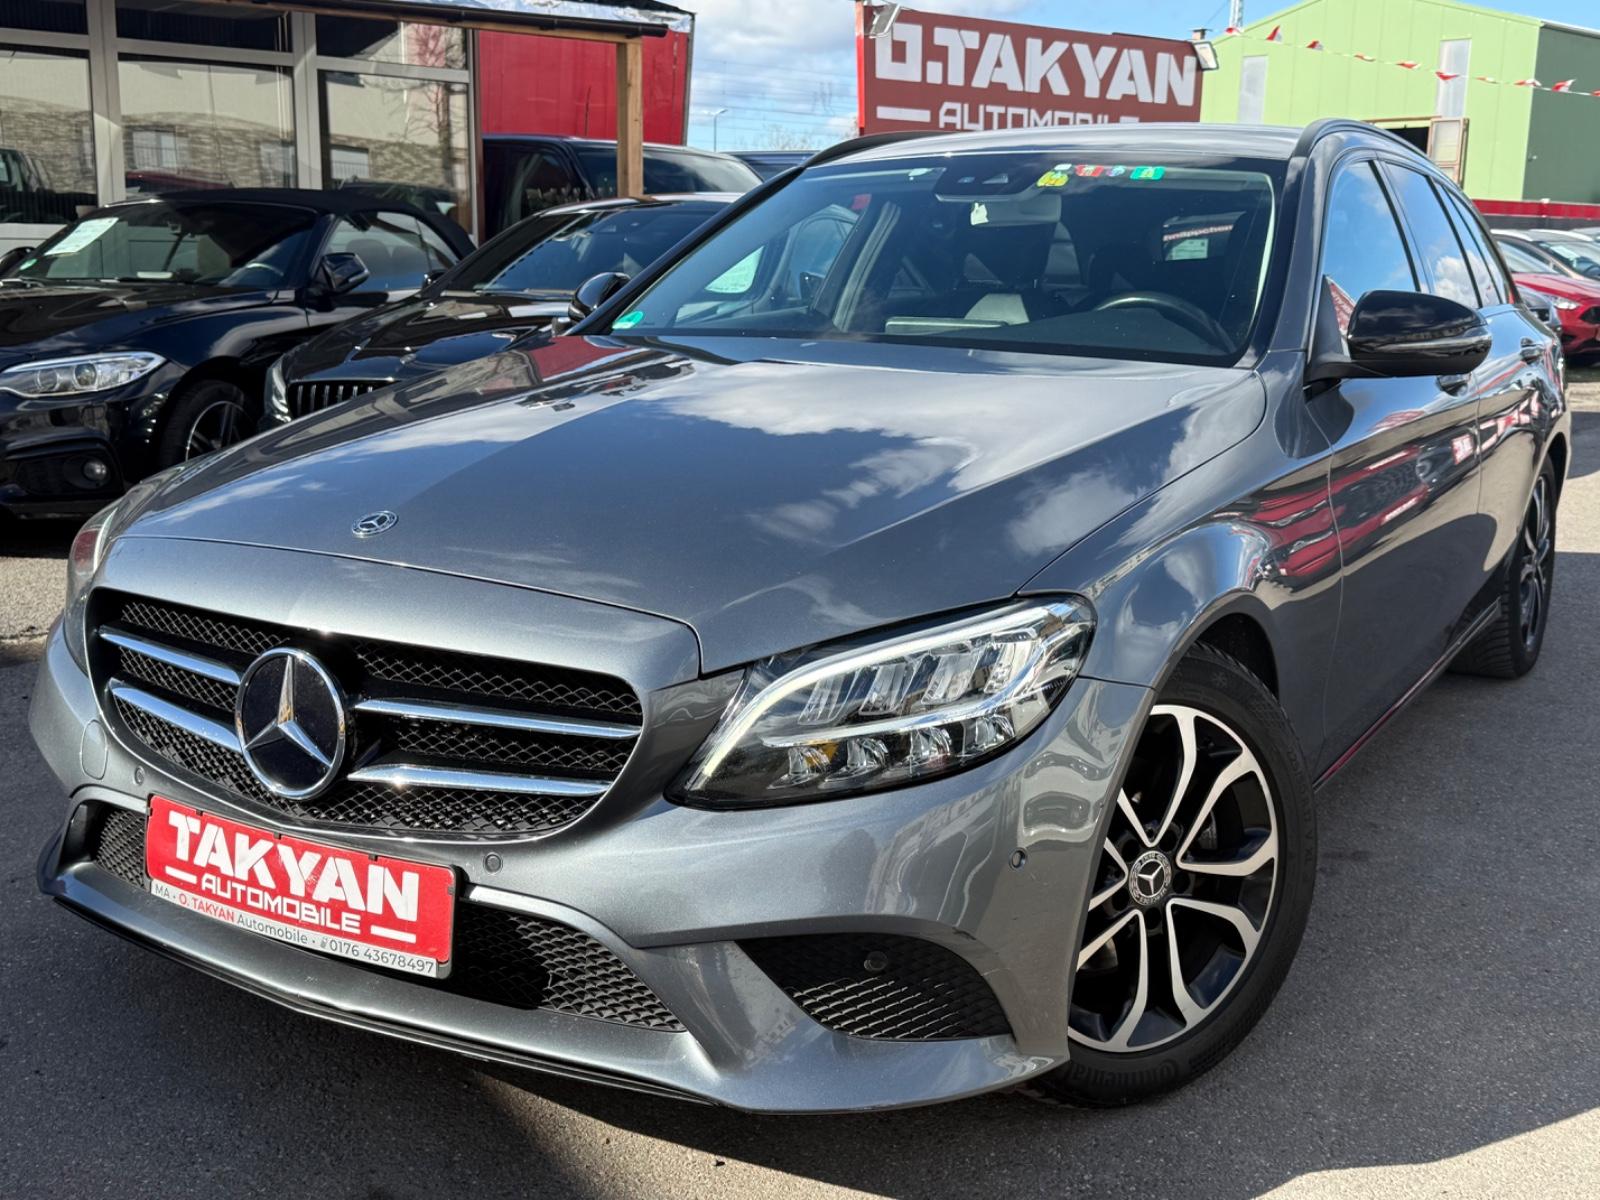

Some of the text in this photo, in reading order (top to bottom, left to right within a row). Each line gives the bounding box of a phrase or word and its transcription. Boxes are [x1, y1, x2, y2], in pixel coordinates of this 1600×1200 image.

[938, 101, 1140, 131] AUTOMO
[168, 810, 420, 922] TAKYAN
[201, 873, 361, 934] AUTOMOBILE
[154, 884, 171, 899] MA
[191, 898, 235, 922] TAKYAN
[237, 913, 309, 945] Automobile
[329, 939, 361, 957] 0176
[363, 947, 435, 974] 43678497
